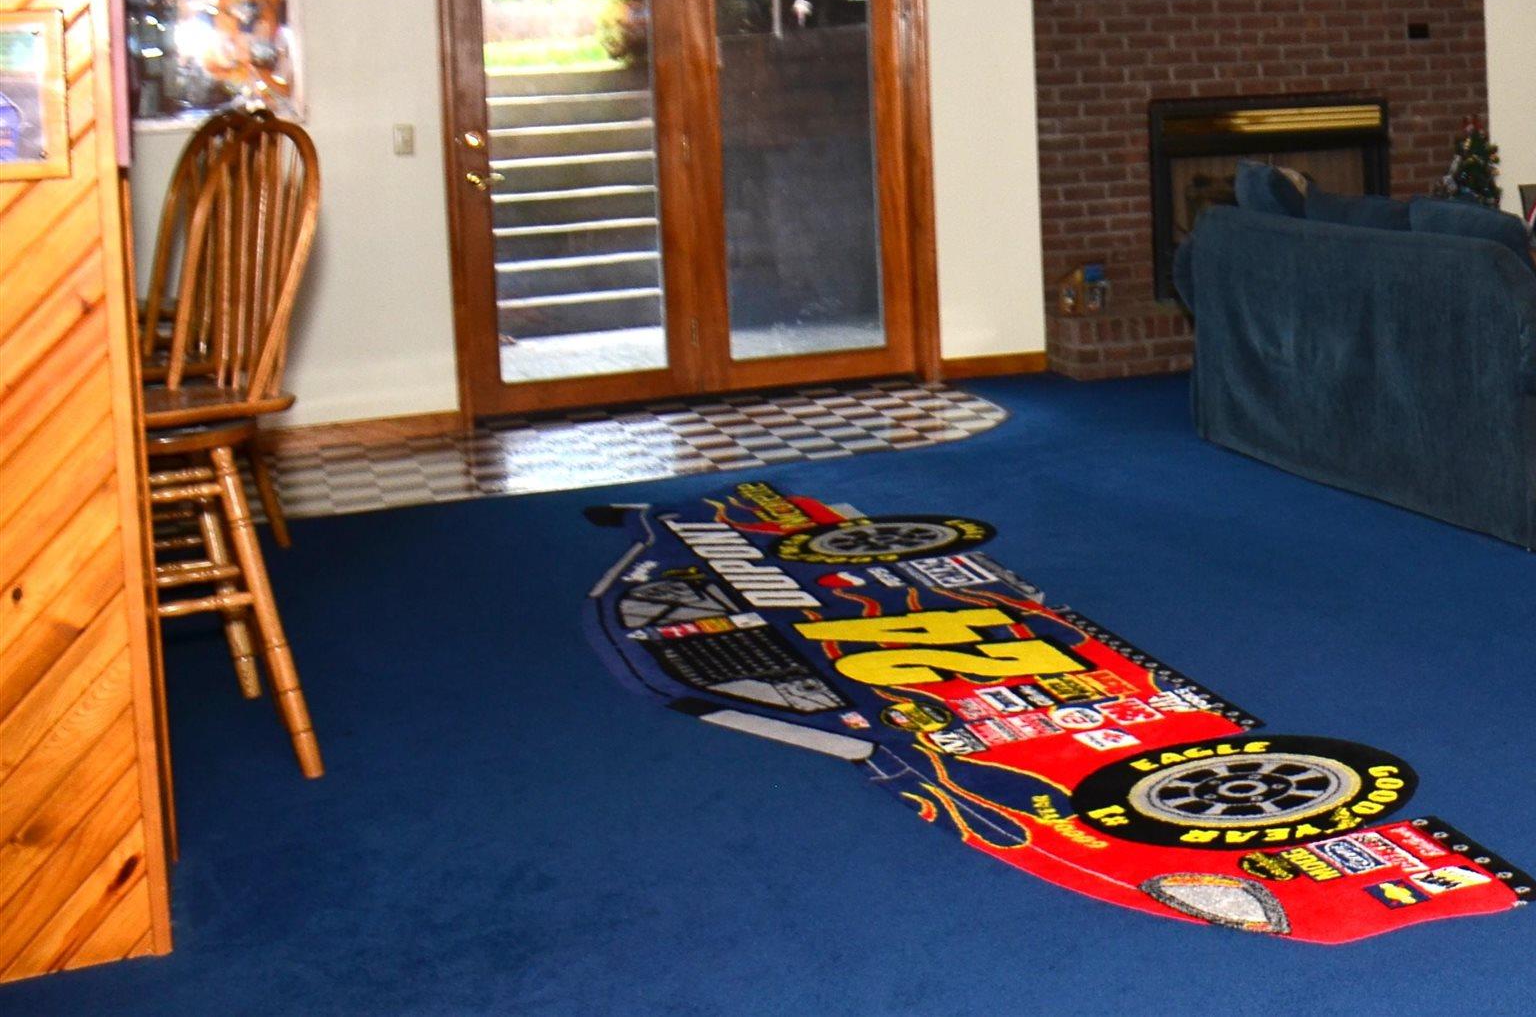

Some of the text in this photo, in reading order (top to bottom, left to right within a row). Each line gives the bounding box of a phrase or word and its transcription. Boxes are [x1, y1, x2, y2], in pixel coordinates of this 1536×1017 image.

[664, 520, 823, 608] DUPONT
[793, 608, 1088, 685] 24
[1129, 741, 1271, 772] EAGLE
